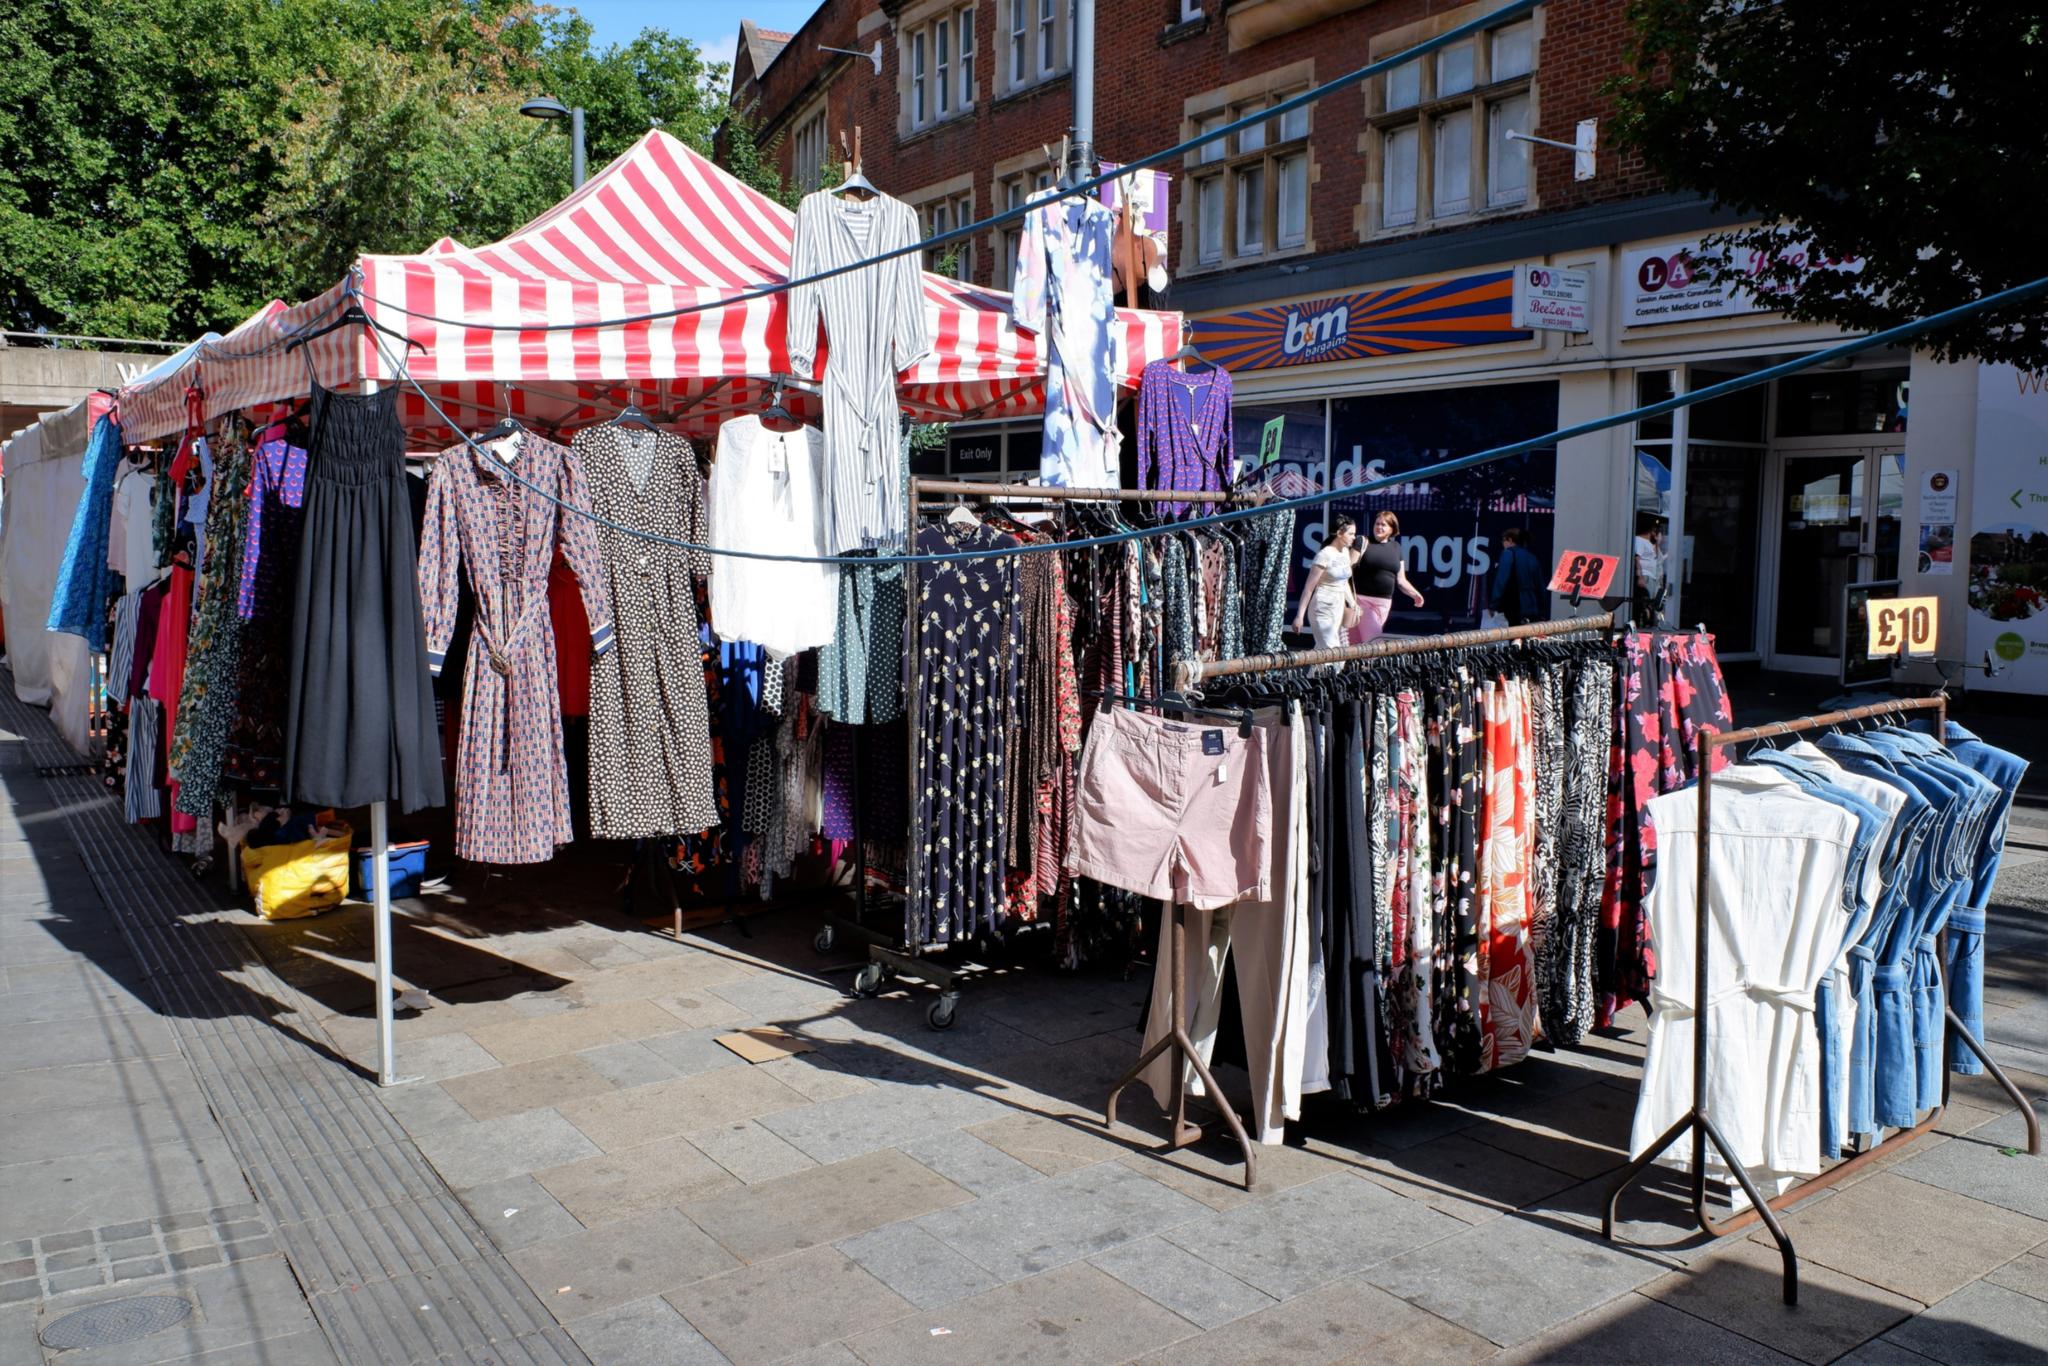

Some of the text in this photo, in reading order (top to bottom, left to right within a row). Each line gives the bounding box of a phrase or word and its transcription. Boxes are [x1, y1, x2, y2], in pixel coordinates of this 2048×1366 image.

[1637, 287, 1722, 304] London Aesthetic Consultants
[1529, 299, 1566, 316] BeeZee
[1635, 299, 1724, 316] Cosmetic Medical Clinic
[1305, 335, 1347, 358] bargains
[959, 447, 993, 462] Exit Only
[1301, 522, 1492, 589] Sngs
[1565, 555, 1604, 587] £8
[1878, 605, 1930, 647] £10
